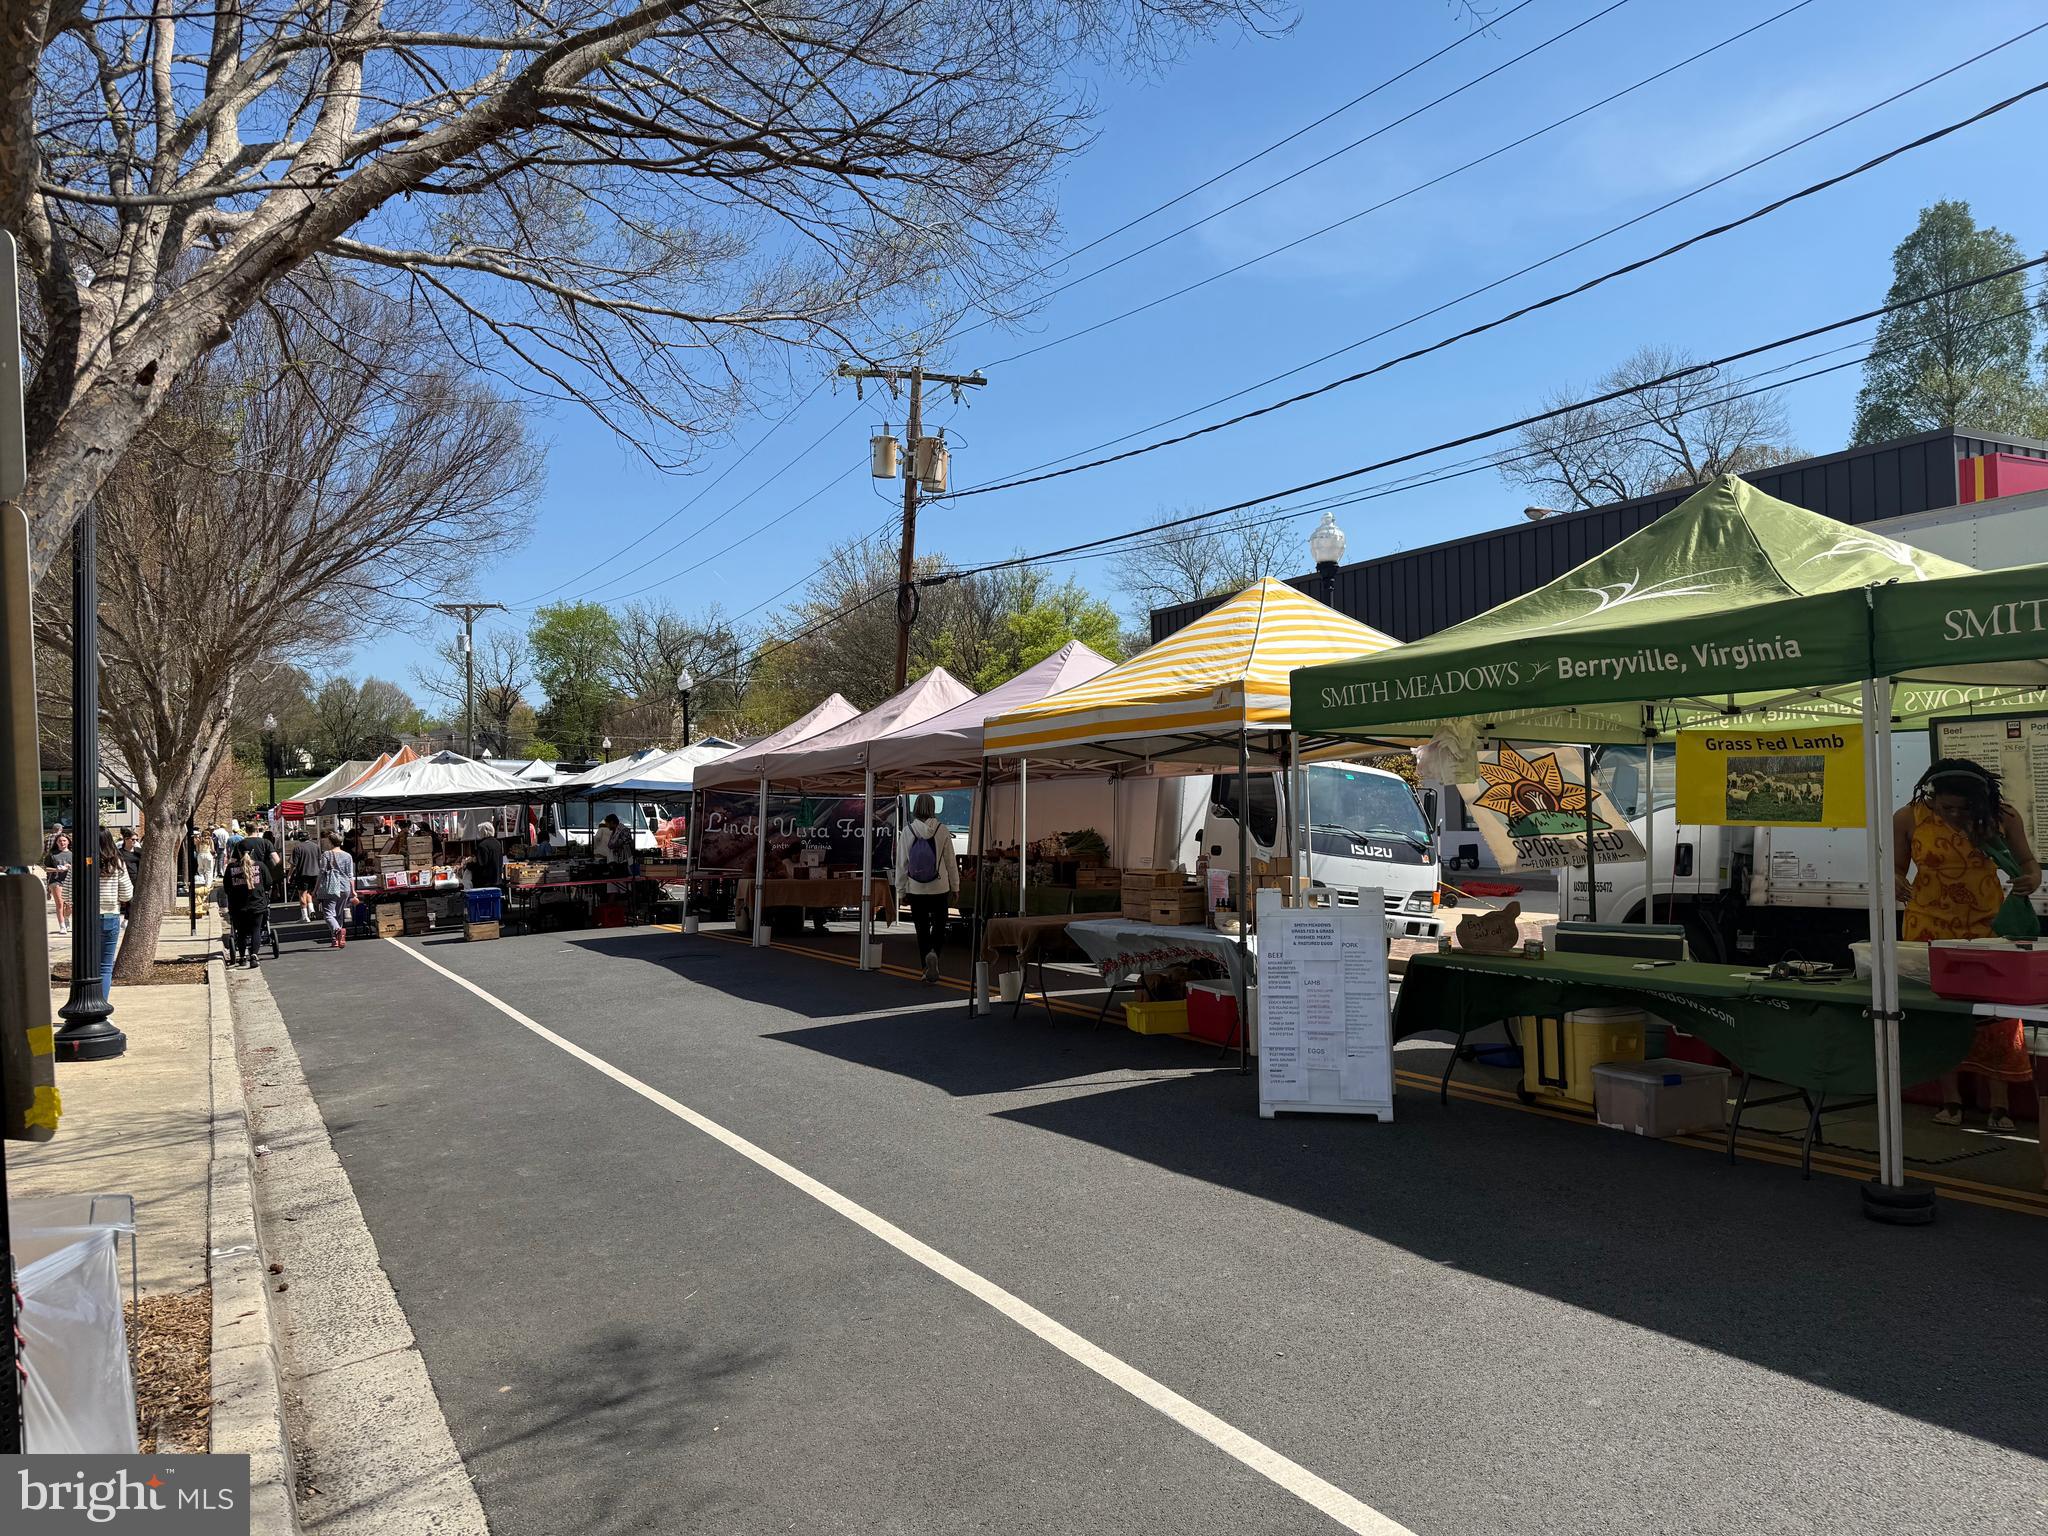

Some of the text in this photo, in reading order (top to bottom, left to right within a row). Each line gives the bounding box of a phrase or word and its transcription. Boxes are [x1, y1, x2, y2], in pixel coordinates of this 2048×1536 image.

[1557, 635, 1802, 681] Berryville, Virginia
[1321, 661, 1519, 708] SMITH MEADOWS
[1943, 727, 1962, 735] Beef
[1705, 734, 1844, 751] Grass Fed Lamb
[773, 816, 830, 838] Vista
[837, 818, 891, 838] Fam
[1351, 843, 1392, 858] ISUZU
[1512, 837, 1569, 859] SPORE
[1532, 858, 1559, 868] FLOWER
[1563, 857, 1568, 866] &
[1598, 853, 1618, 863] FARM
